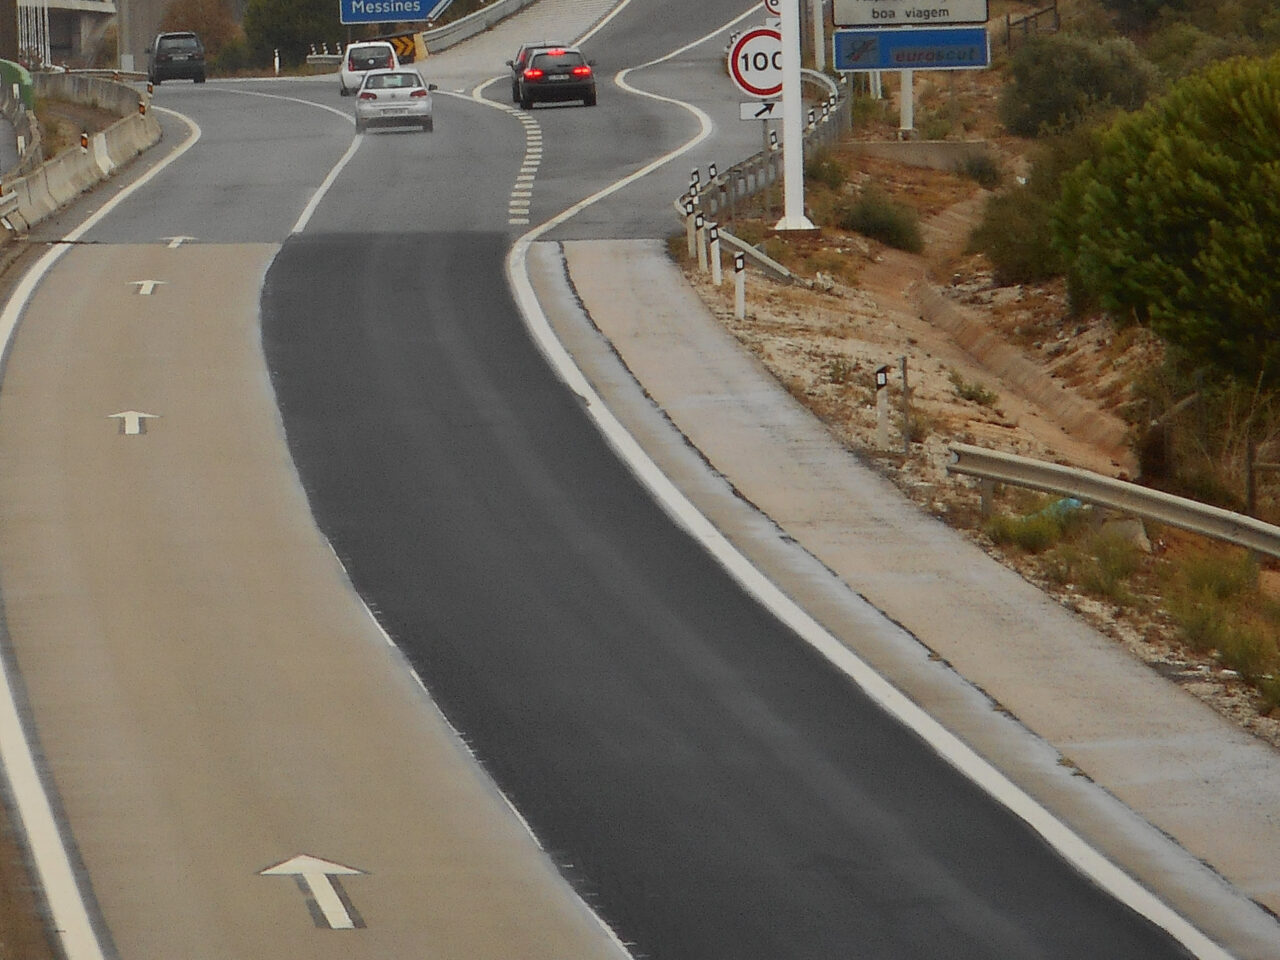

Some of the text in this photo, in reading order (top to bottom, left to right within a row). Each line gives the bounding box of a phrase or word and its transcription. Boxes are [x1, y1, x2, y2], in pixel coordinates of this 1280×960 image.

[351, 0, 421, 14] Messines
[871, 7, 950, 20] boa viagem
